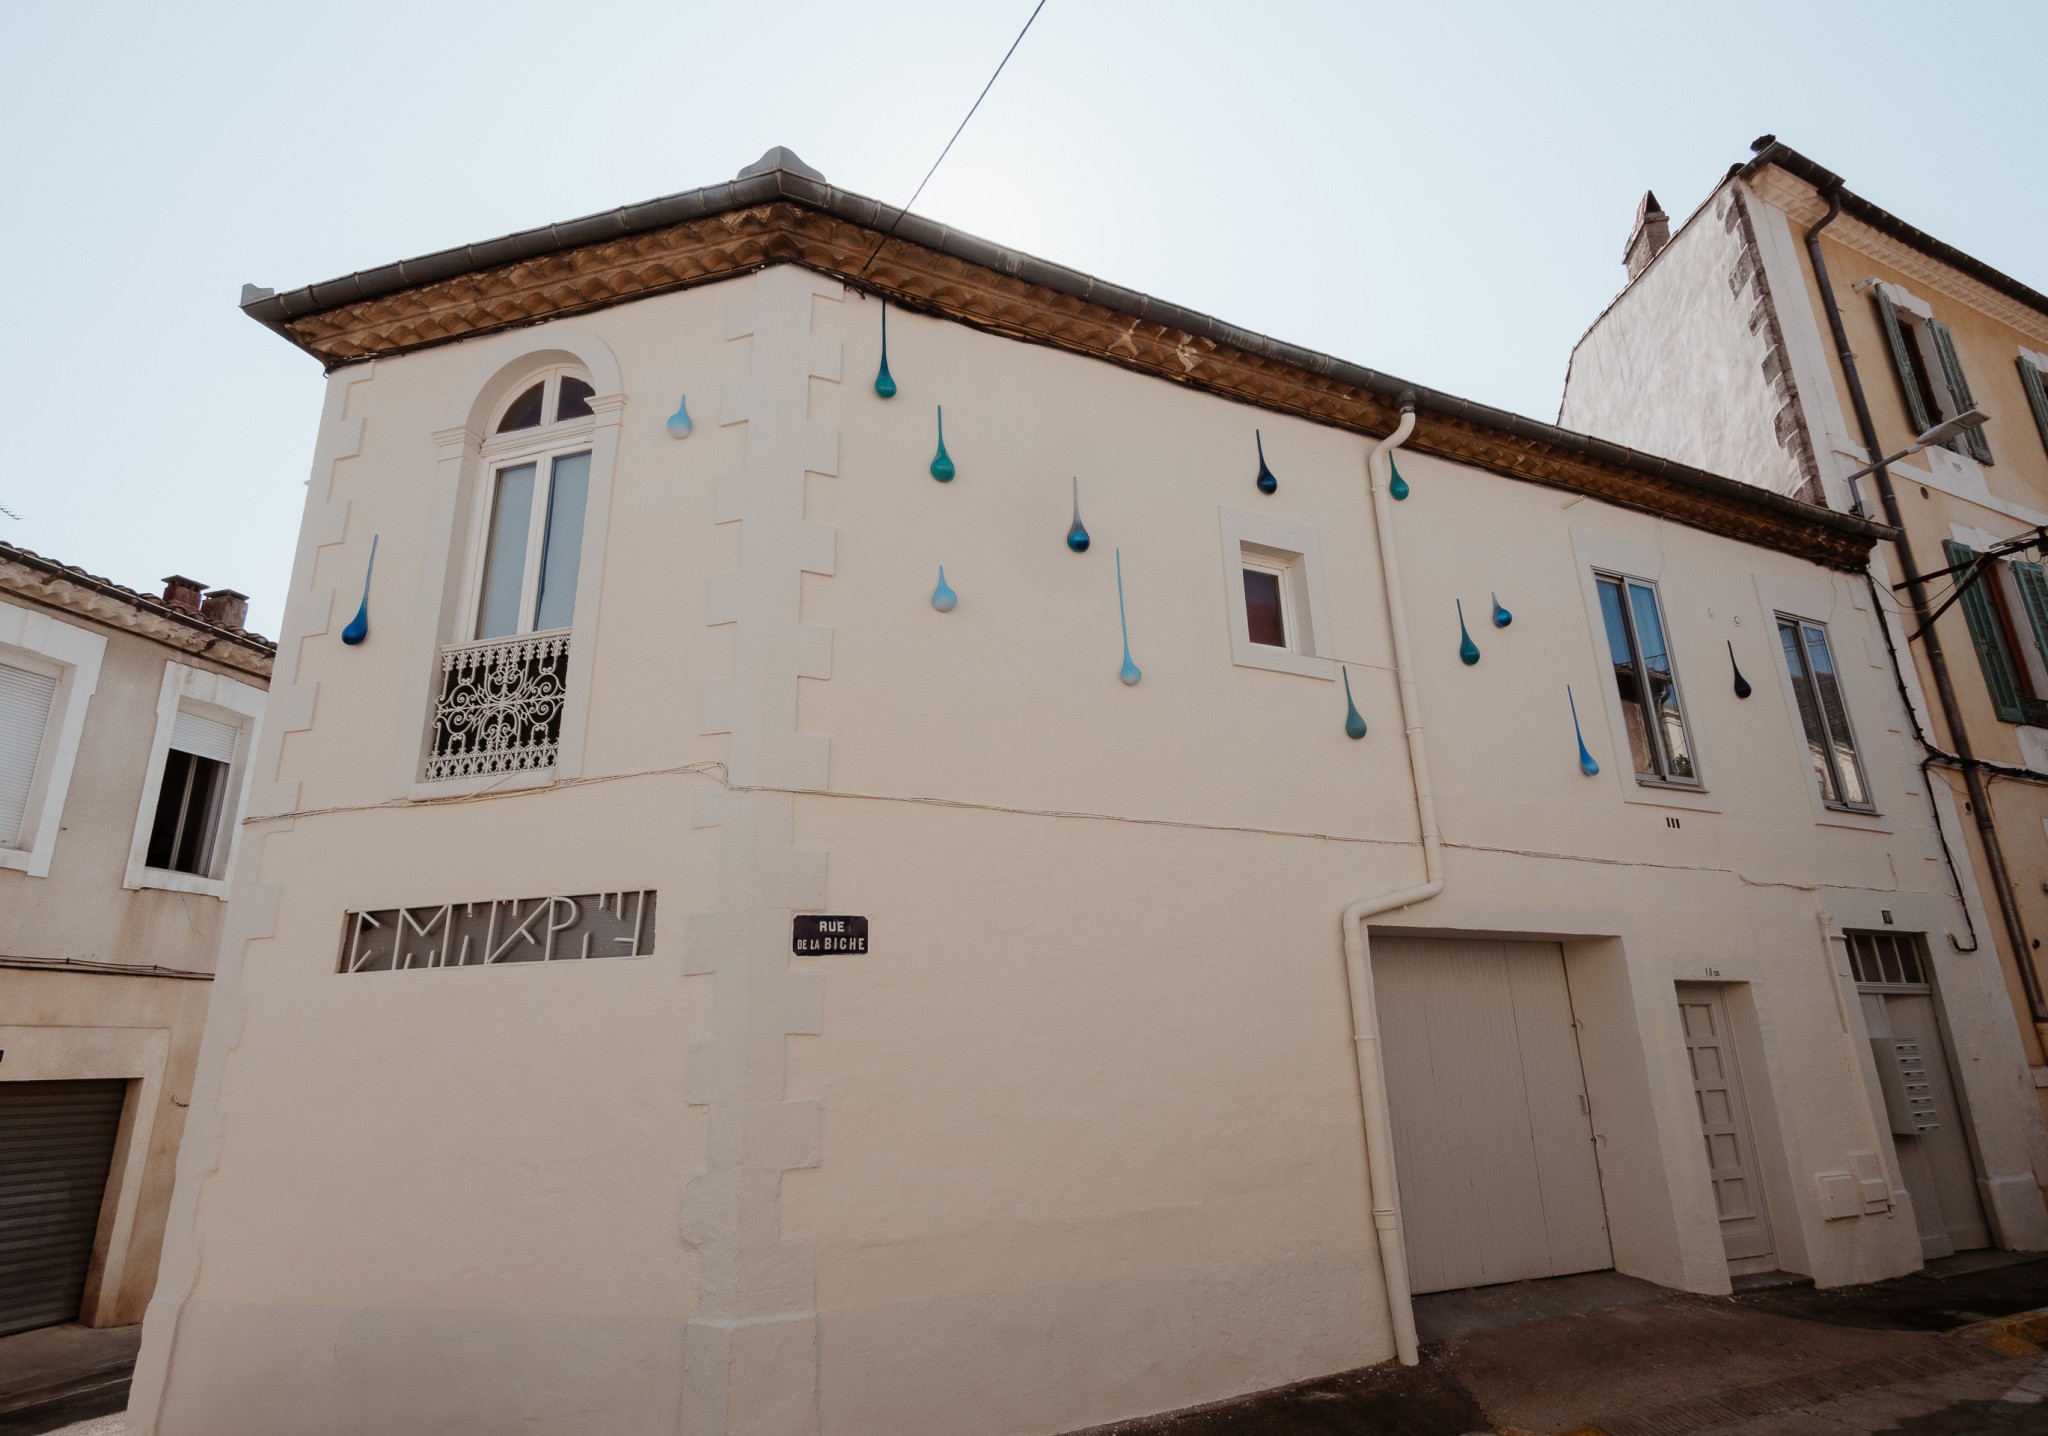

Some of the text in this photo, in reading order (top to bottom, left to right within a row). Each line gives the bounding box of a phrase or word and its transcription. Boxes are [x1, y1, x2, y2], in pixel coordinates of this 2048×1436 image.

[819, 921, 845, 933] RUE
[797, 937, 865, 950] DE LA BICHE
